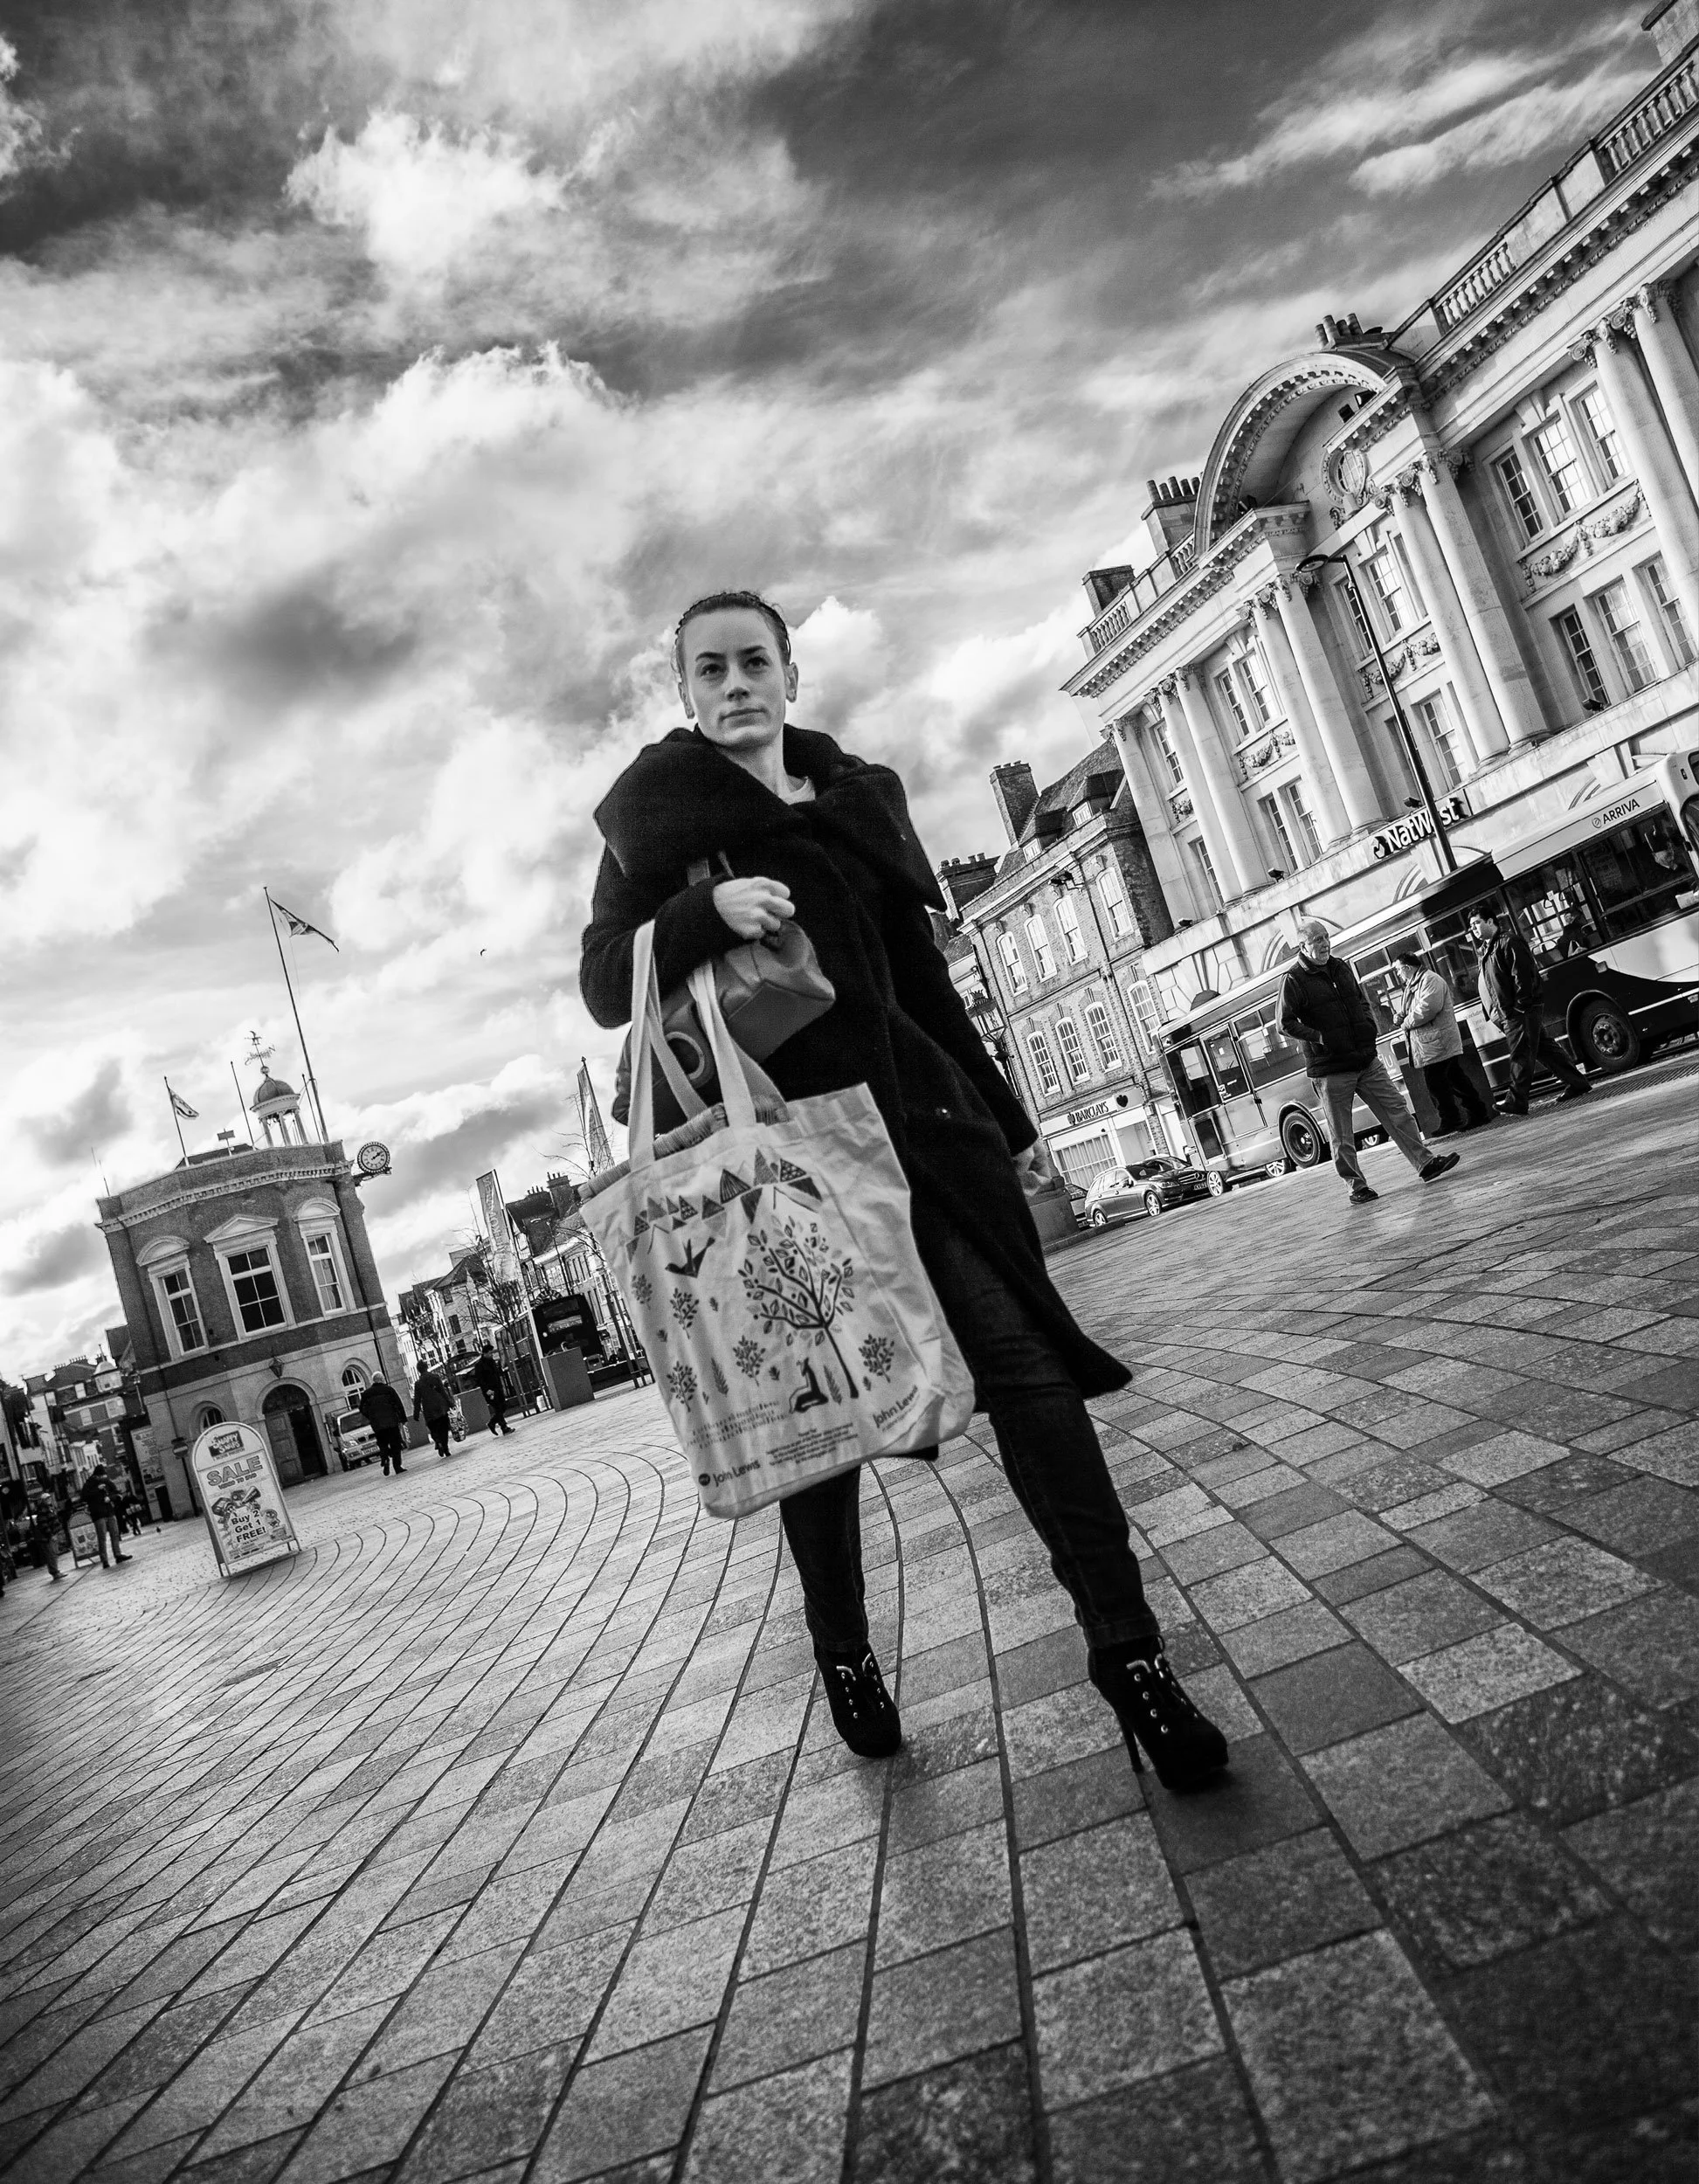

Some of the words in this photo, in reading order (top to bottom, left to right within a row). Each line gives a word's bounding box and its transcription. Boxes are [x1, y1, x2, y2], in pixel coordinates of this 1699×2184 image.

[1602, 798, 1640, 826] ARRIVA
[1387, 798, 1459, 853] NatWst
[1075, 1101, 1109, 1123] BARCLAYS
[873, 1406, 897, 1428] John
[207, 1455, 263, 1487] SALE
[713, 1470, 733, 1488] John
[231, 1515, 250, 1525] Buy
[235, 1523, 253, 1533] Get
[236, 1526, 266, 1543] FREE!
